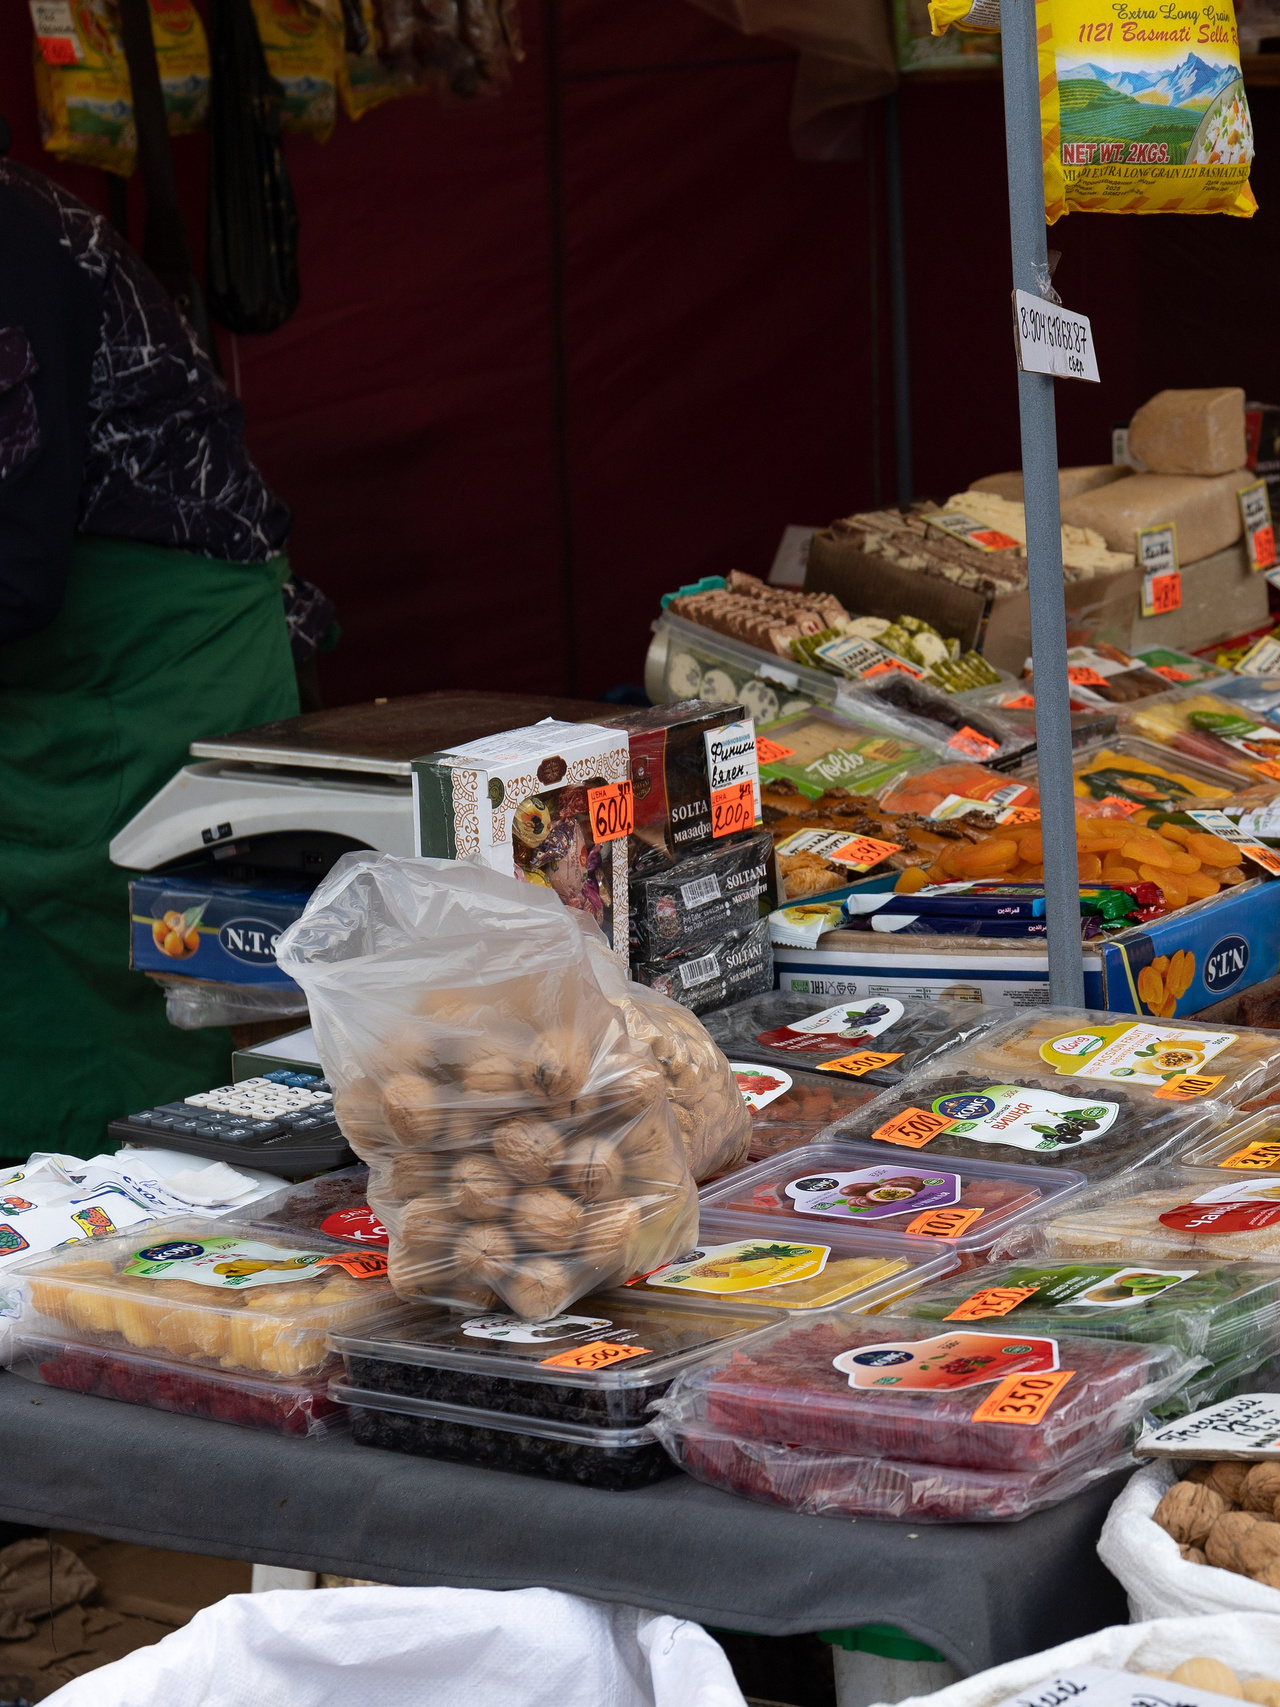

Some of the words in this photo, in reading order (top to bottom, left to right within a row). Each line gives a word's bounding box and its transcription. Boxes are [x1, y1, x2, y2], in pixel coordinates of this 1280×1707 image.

[1112, 3, 1157, 20] Extra
[1160, 3, 1200, 25] Long
[1202, 6, 1231, 25] Grain
[1078, 22, 1113, 43] 1121
[1120, 21, 1191, 43] Basmati
[1197, 23, 1229, 43] Sella
[1063, 143, 1097, 164] NET
[1100, 143, 1124, 164] WT.
[1128, 143, 1170, 164] 2KGS.
[1092, 167, 1122, 179] EXTRA
[1124, 167, 1150, 178] LONG
[1151, 167, 1182, 178] GRAIN
[1182, 168, 1198, 178] 1121
[1200, 167, 1237, 178] BASMATI
[711, 741, 755, 763] Финики
[712, 765, 748, 787] вялен.
[591, 789, 607, 800] ЦЕНА
[672, 800, 708, 823] SOLTA
[674, 822, 712, 843] мазафа
[726, 864, 767, 889] SOLTANI
[726, 943, 763, 969] SOLTANI
[840, 1056, 887, 1071] 600
[1093, 1043, 1126, 1068] PASSION
[953, 1097, 989, 1119] KONG
[901, 1113, 944, 1141] 500
[153, 1243, 199, 1260] KONG
[998, 1379, 1054, 1415] 350
[1154, 1399, 1263, 1443] Грецкий
